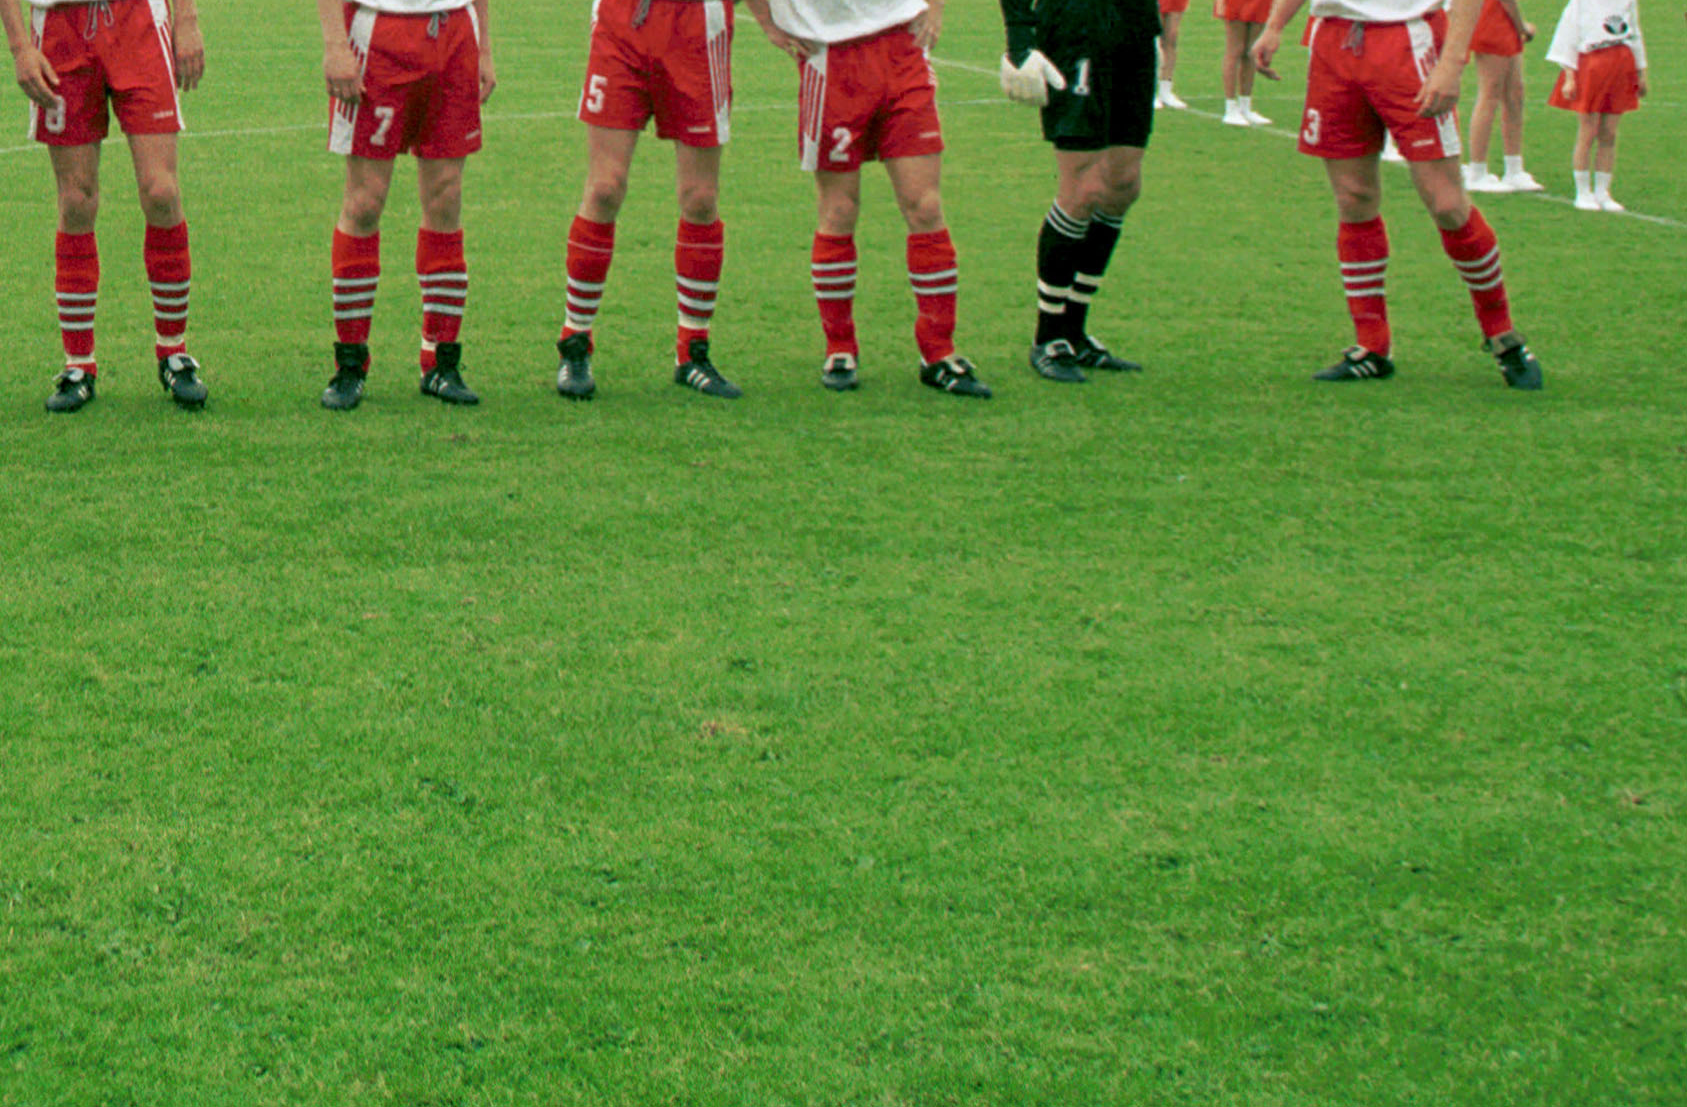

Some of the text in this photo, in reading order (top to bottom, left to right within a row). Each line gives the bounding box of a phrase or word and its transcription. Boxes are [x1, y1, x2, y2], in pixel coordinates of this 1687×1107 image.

[586, 74, 607, 113] 5
[1074, 59, 1090, 95] 1
[370, 106, 394, 146] 7
[829, 127, 853, 162] 2
[1302, 108, 1321, 145] 3
